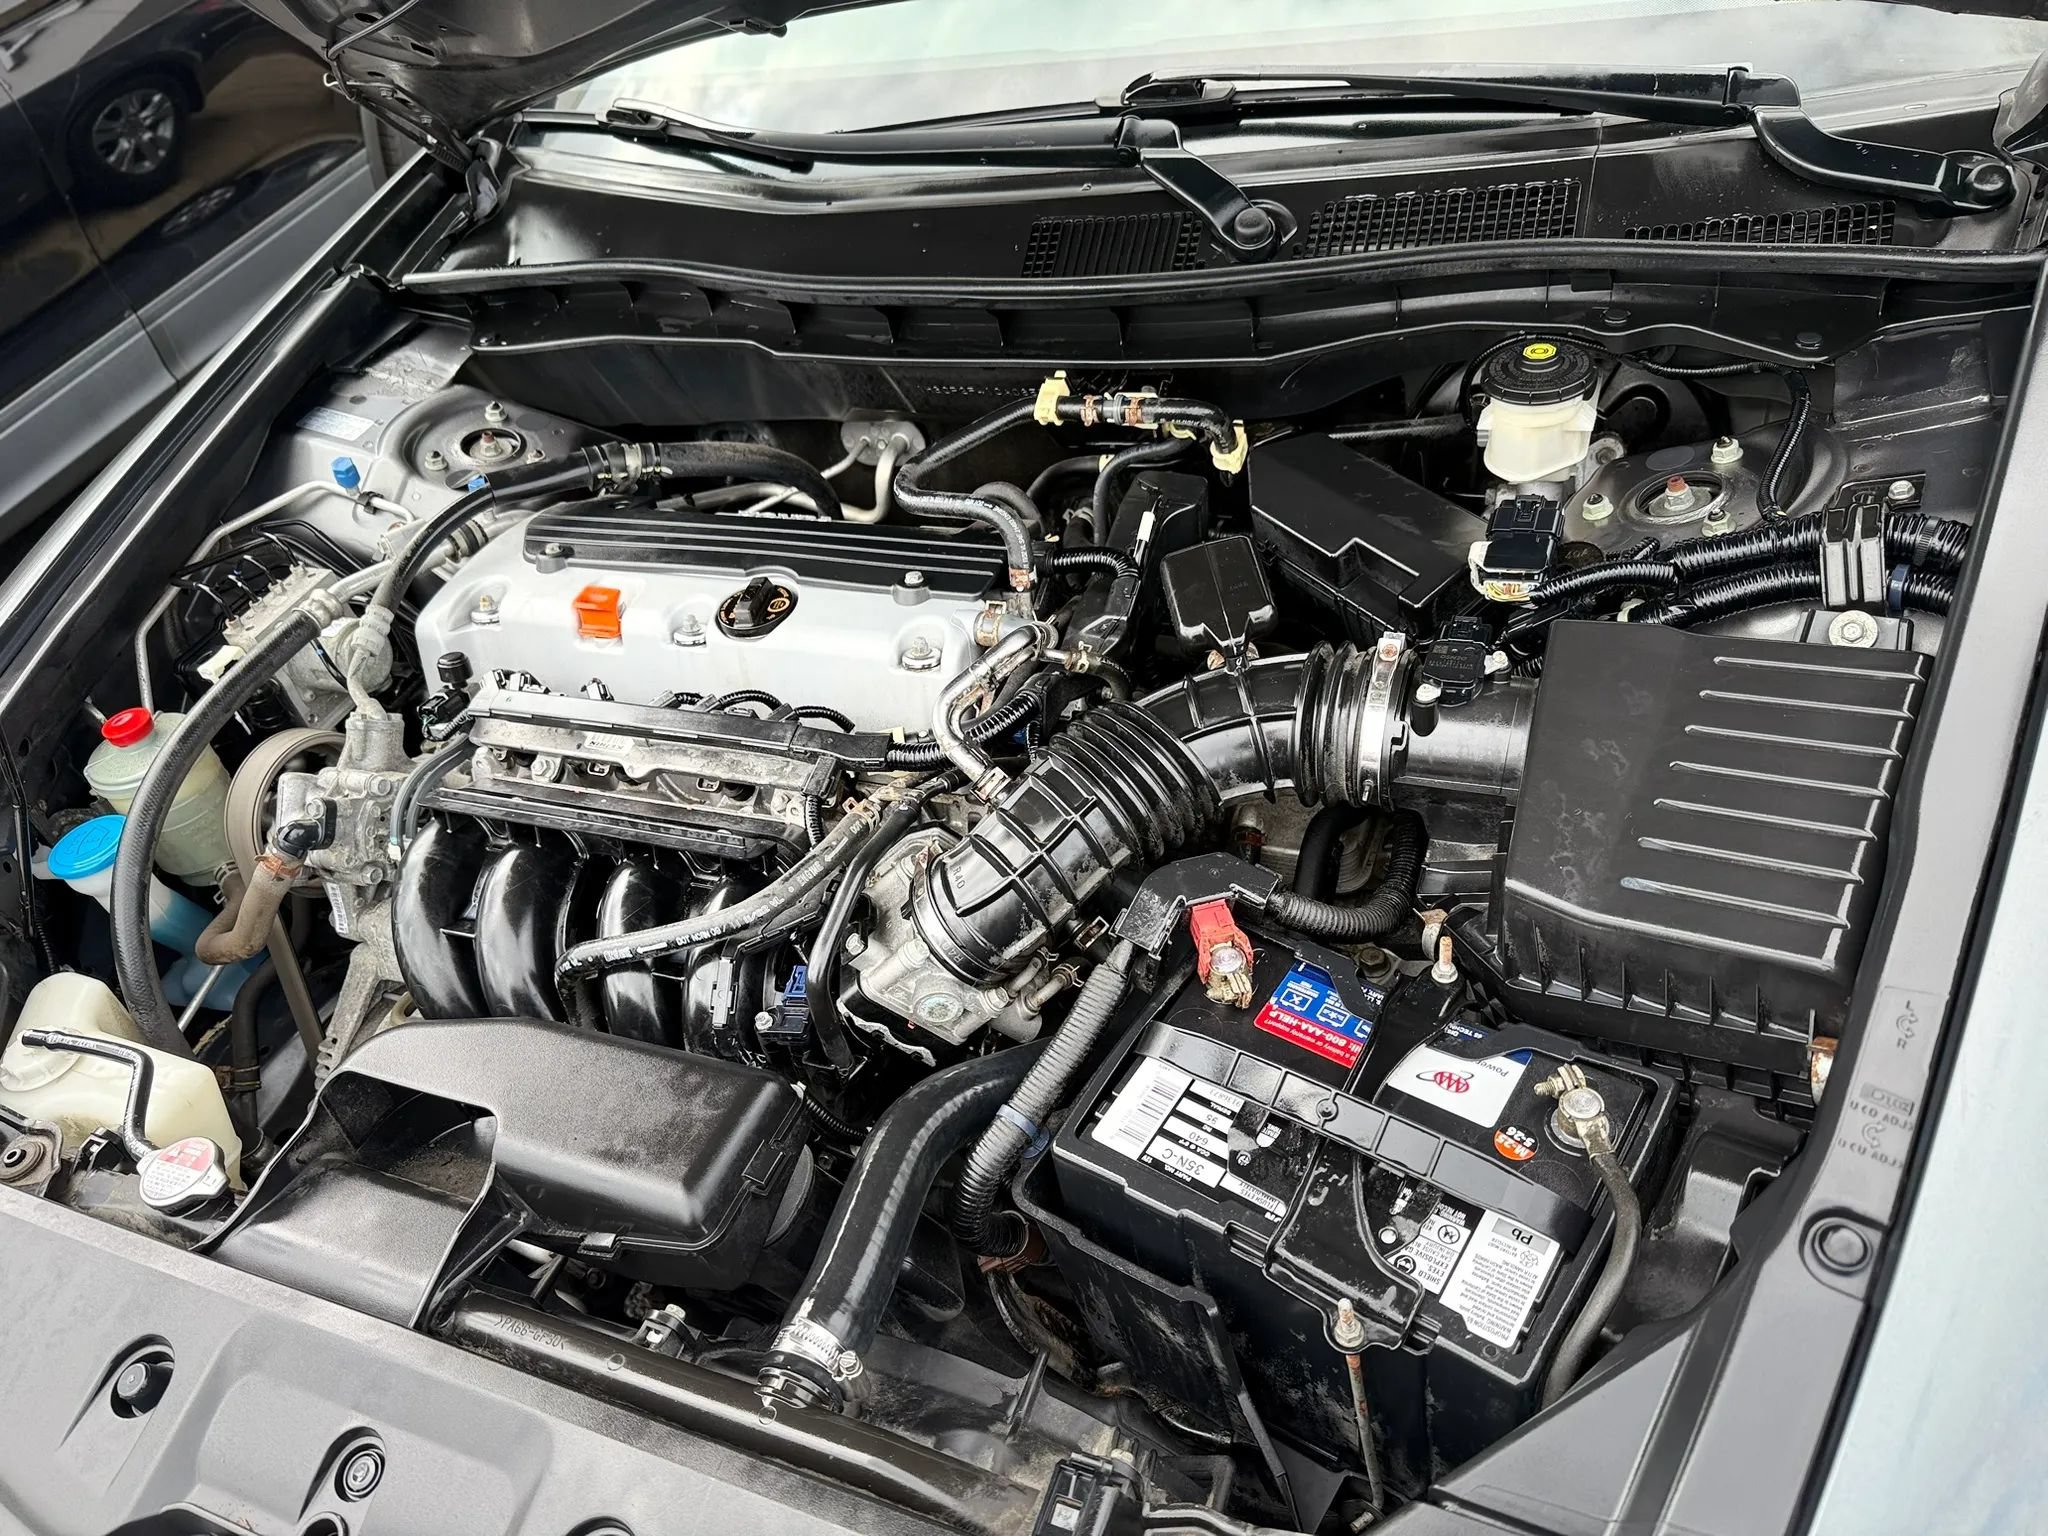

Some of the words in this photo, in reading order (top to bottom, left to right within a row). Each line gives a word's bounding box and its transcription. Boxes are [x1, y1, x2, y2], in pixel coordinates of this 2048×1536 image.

[1268, 1007, 1347, 1047] 800-AAA-HELP
[1433, 1071, 1470, 1094] AAA
[1204, 1112, 1218, 1125] 95
[1208, 1099, 1231, 1117] SERIAL
[1188, 1130, 1209, 1146] 640
[1495, 1131, 1529, 1159] M-25
[1505, 1125, 1535, 1148] 5-26
[1160, 1146, 1204, 1176] 35N-C
[1162, 1163, 1175, 1174] NO.
[1173, 1168, 1192, 1183] PART
[1509, 1225, 1533, 1246] Pb
[1412, 1248, 1448, 1270] EXPLOSIVE
[1417, 1269, 1440, 1285] SHIELD
